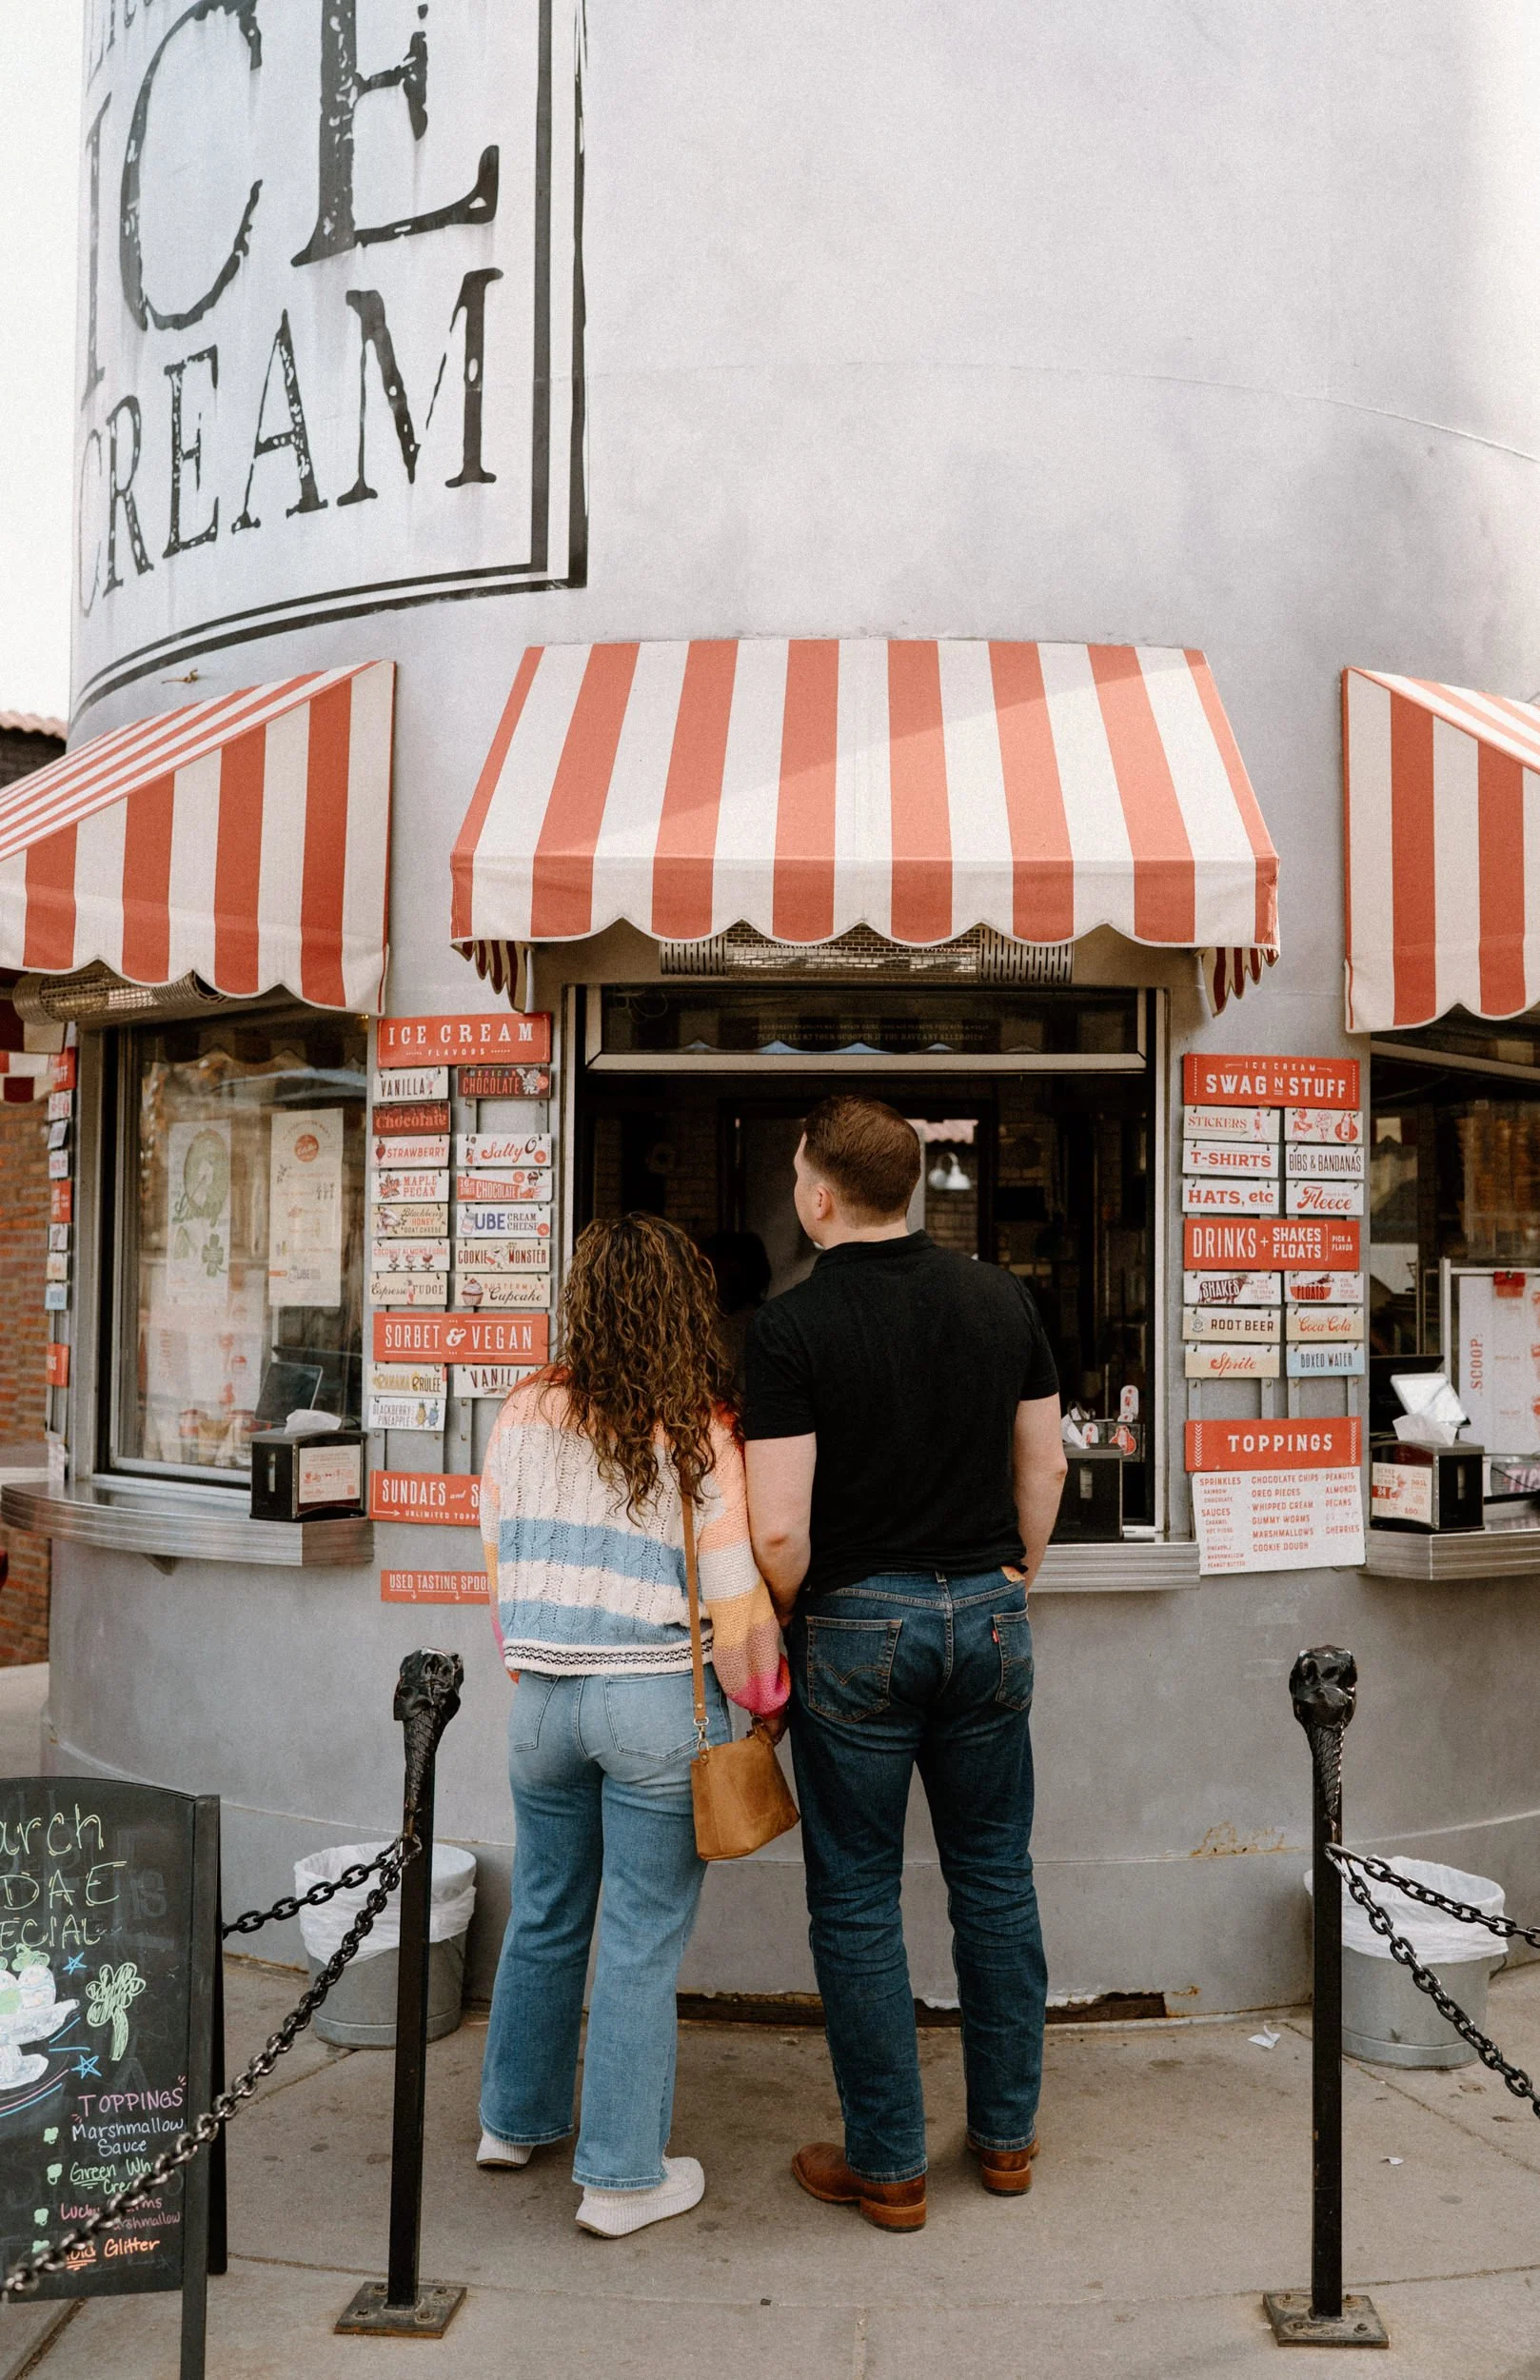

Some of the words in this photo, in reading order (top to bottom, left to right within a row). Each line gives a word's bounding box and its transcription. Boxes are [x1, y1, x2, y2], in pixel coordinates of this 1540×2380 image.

[80, 268, 504, 617] CREAM
[388, 1025, 426, 1045] ICE
[440, 1022, 534, 1043] CREAM
[427, 1048, 485, 1057] FLAVORS
[1245, 1061, 1267, 1070] ICE
[1273, 1061, 1316, 1072] CREAM
[381, 1078, 425, 1097] VANILLA
[463, 1077, 520, 1095] CHOCOLATE
[1205, 1074, 1267, 1095] SWAG
[1273, 1077, 1284, 1089] N
[1289, 1077, 1347, 1099] STUFF
[376, 1109, 447, 1129] Chocolate
[1188, 1116, 1248, 1129] STICKERS
[386, 1147, 446, 1159] STRAWBERRY
[1190, 1152, 1272, 1168] T-SHIRTS
[1289, 1153, 1307, 1171] BIBS
[1310, 1155, 1316, 1169] &
[1318, 1153, 1362, 1173] BANDANAS
[404, 1176, 437, 1186] MAPLE
[404, 1187, 436, 1197] PECAN
[476, 1180, 518, 1200] CHOCOLATE
[1188, 1189, 1245, 1207] HATS,
[1249, 1190, 1274, 1203] etc
[1296, 1184, 1352, 1210] Fleece
[476, 1213, 505, 1230] UBE
[507, 1212, 537, 1221] CREAM
[507, 1222, 539, 1231] CHEESE
[1272, 1227, 1321, 1242] SHAKES
[1193, 1227, 1256, 1259] DRINKS
[1273, 1243, 1321, 1259] FLOATS
[458, 1249, 488, 1264] COOKIE
[508, 1249, 546, 1264] MONSTER
[412, 1284, 444, 1295] FUDGE
[488, 1286, 542, 1304] Cupcake
[1202, 1279, 1239, 1299] SHAKES
[1296, 1286, 1325, 1300] FLOATS
[1211, 1319, 1241, 1331] ROOT
[1244, 1319, 1273, 1332] BEER
[1298, 1317, 1325, 1333] Coca
[1326, 1317, 1352, 1333] Cola
[385, 1324, 440, 1349] SORBET
[445, 1327, 466, 1347] &
[471, 1325, 533, 1350] VEGAN
[1210, 1352, 1257, 1376] Sprite
[1300, 1353, 1325, 1368] BOXED
[1328, 1352, 1352, 1367] WATER
[1470, 1338, 1484, 1390] SCOOP
[377, 1416, 410, 1426] PINEAPPLE
[1228, 1433, 1333, 1453] TOPPINGS
[1199, 1477, 1241, 1486] SPRINKLES
[1251, 1475, 1295, 1484] CHOCOLATE
[1298, 1474, 1319, 1482] CHIPS
[1325, 1472, 1355, 1481] PEANUTS
[382, 1478, 446, 1506] SUNDAES
[449, 1490, 466, 1500] and
[1252, 1489, 1273, 1497] OREO
[1274, 1488, 1301, 1497] PIECES
[1325, 1485, 1357, 1494] ALMONDS
[1252, 1501, 1287, 1512] WHIPPED
[1289, 1500, 1313, 1510] CREAM
[1325, 1498, 1352, 1507] PECANS
[404, 1510, 449, 1519] UNLIMITED
[1201, 1508, 1231, 1517] SAUCES
[1252, 1516, 1280, 1525] GUMMY
[1283, 1515, 1311, 1523] WORMS
[1253, 1527, 1314, 1538] MARSHMALLOWS
[1325, 1525, 1360, 1535] CHERRIES
[1253, 1543, 1280, 1553] COOKIE
[1283, 1542, 1309, 1551] DOUGH
[389, 1574, 413, 1589] USED
[417, 1575, 457, 1590] TASTING
[78, 2087, 185, 2117] TOPPINGS
[71, 2117, 185, 2141] Marshmallow
[97, 2138, 148, 2157] Sauce
[69, 2161, 117, 2183] Green
[126, 2156, 154, 2176] Wh
[104, 2237, 160, 2258] Glitter
